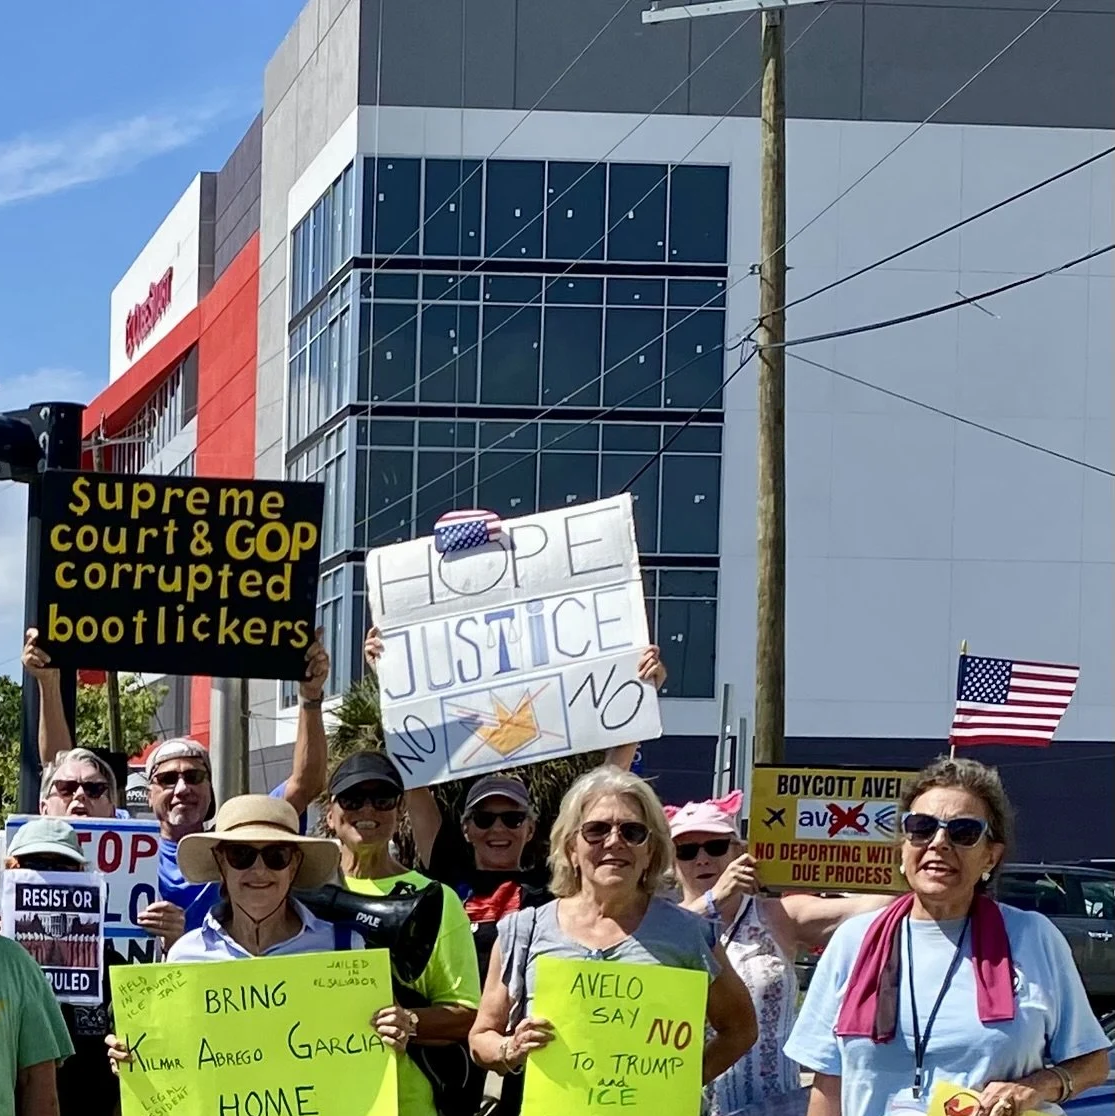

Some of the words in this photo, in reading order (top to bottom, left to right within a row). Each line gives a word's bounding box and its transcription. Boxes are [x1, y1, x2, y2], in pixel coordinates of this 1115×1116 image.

[50, 519, 179, 555] court
[190, 520, 213, 557] &
[225, 519, 317, 562] GOP
[377, 505, 623, 615] HOPE
[55, 561, 292, 602] corrupted
[568, 663, 644, 730] NO
[391, 714, 436, 776] NO
[777, 775, 856, 797] BOYCOTT
[755, 843, 774, 859] NO
[779, 844, 861, 863] DEPORTING
[791, 865, 820, 882] DUE
[825, 866, 892, 885] PROCESS
[22, 888, 69, 907] RESIST
[72, 889, 92, 908] OR
[356, 912, 382, 928] PYLE
[326, 960, 370, 968] JAILED
[118, 975, 148, 996] HELD
[204, 980, 287, 1014] BRING
[570, 972, 643, 1000] AVELO
[589, 1007, 640, 1028] SAY
[124, 1032, 184, 1073] KILMAR
[198, 1038, 263, 1070] ABREGO
[287, 1021, 385, 1060] GARCIA
[646, 1018, 692, 1051] NO
[612, 1054, 684, 1080] TRUMP
[597, 1076, 629, 1087] and
[141, 1086, 181, 1111] LEGAL
[587, 1088, 637, 1106] ICE
